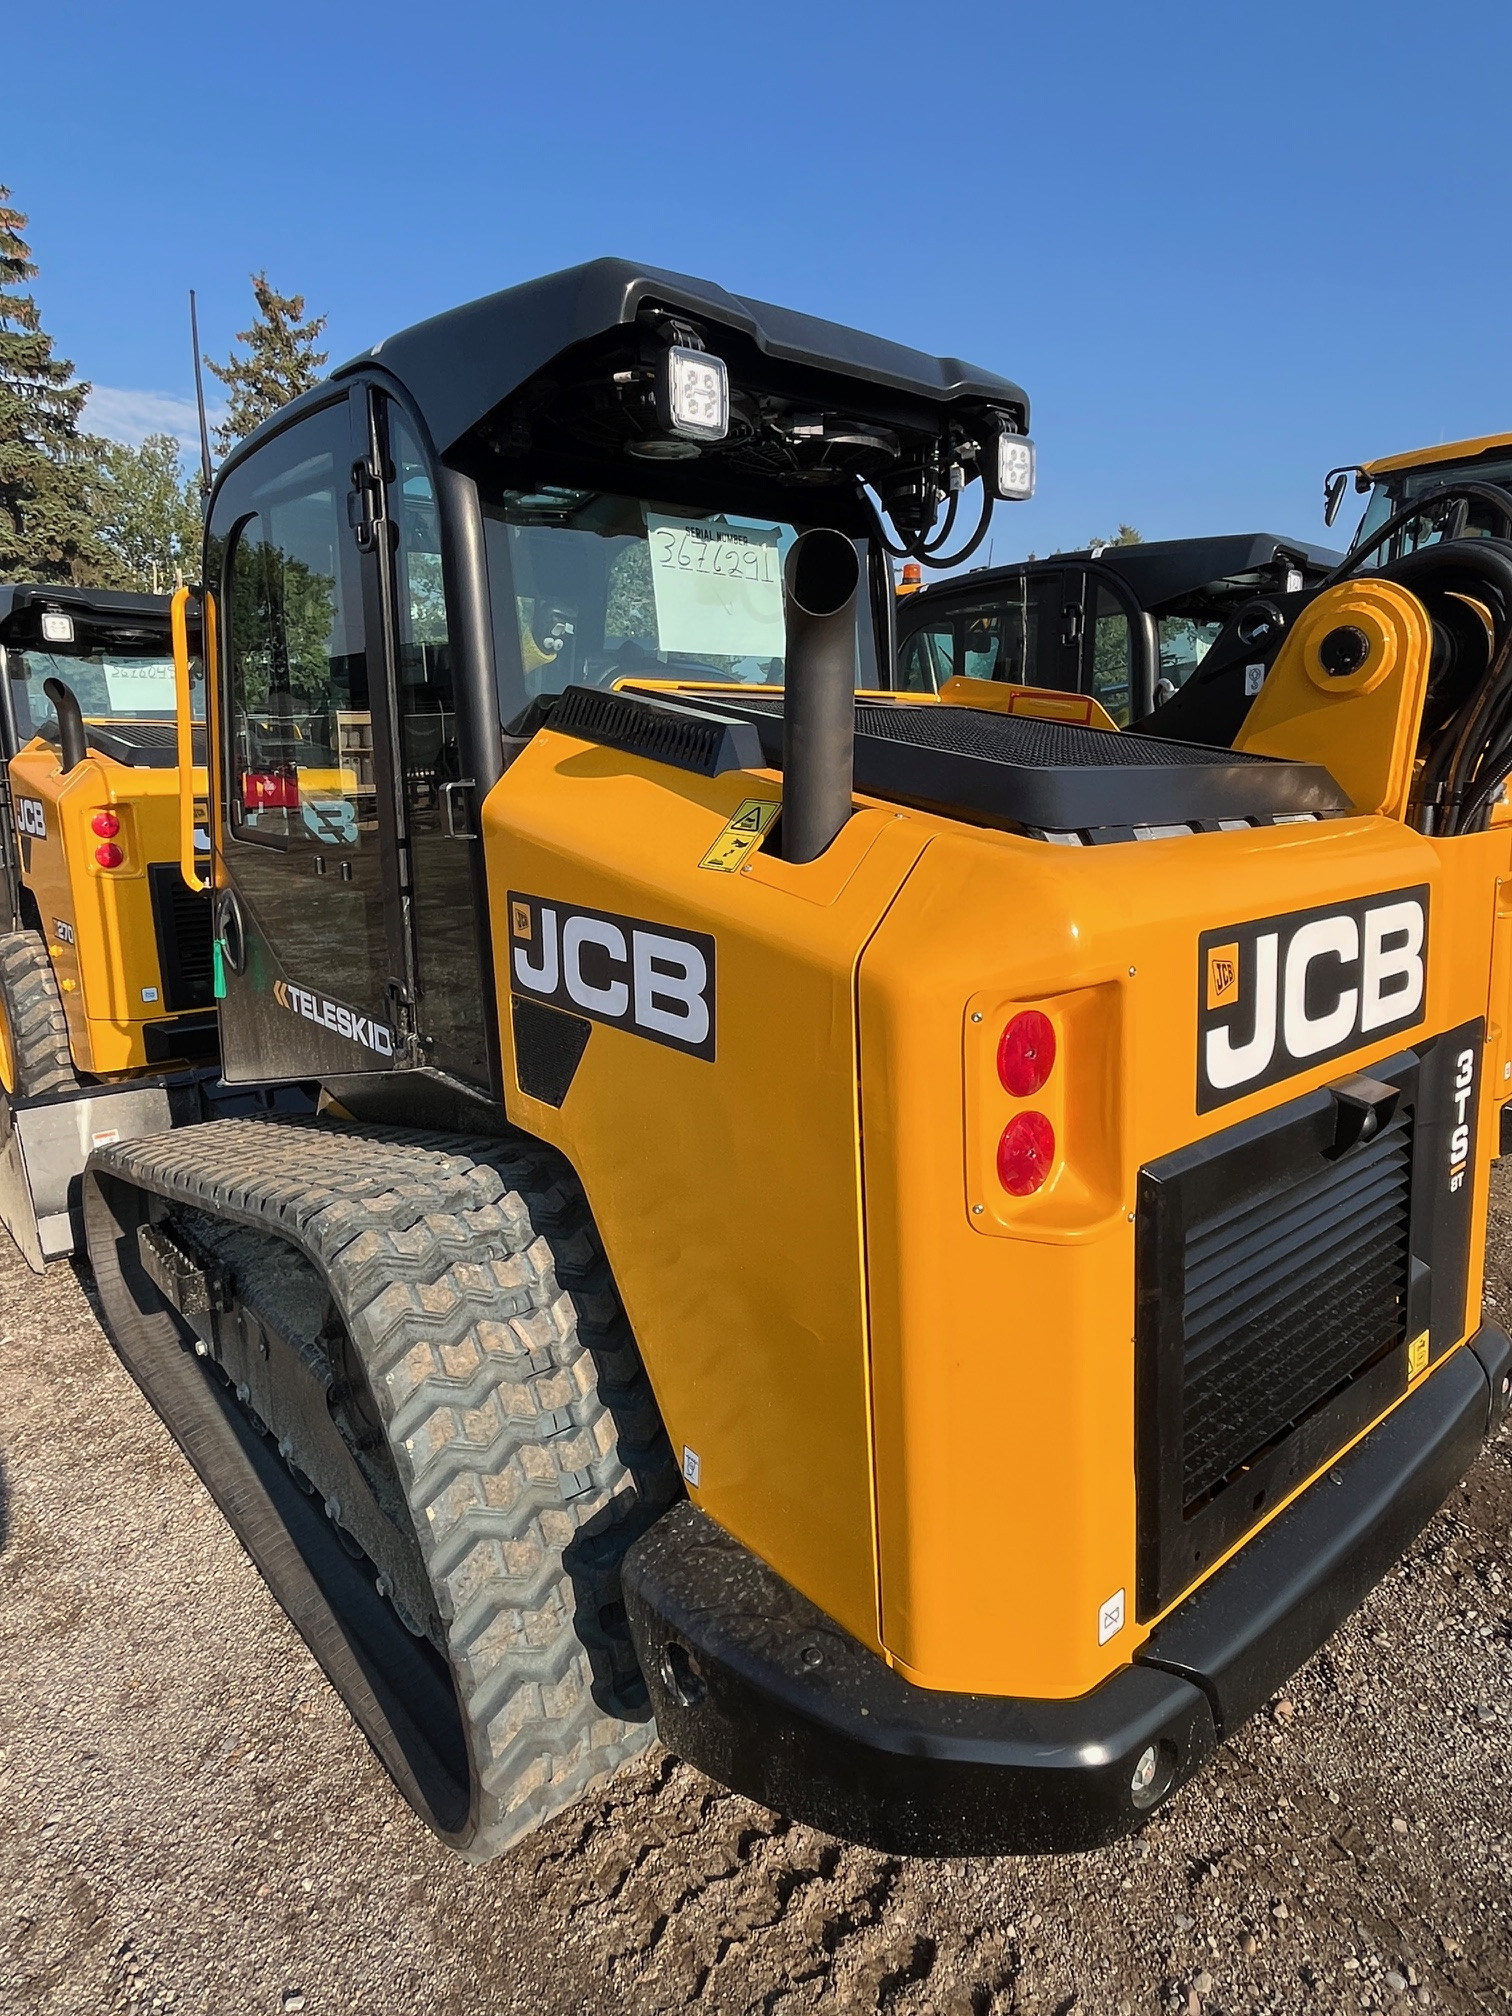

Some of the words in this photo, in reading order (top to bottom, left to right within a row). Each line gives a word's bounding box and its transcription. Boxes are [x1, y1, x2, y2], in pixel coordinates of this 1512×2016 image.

[656, 531, 774, 581] 3676291
[685, 526, 713, 541] SERIAL
[716, 530, 749, 547] NUMBER
[17, 799, 46, 837] JCB
[57, 921, 74, 944] 270
[514, 907, 710, 1044] JCB
[1206, 900, 1424, 1089] JCB
[1216, 962, 1234, 991] JCB
[288, 984, 393, 1057] TELESKID
